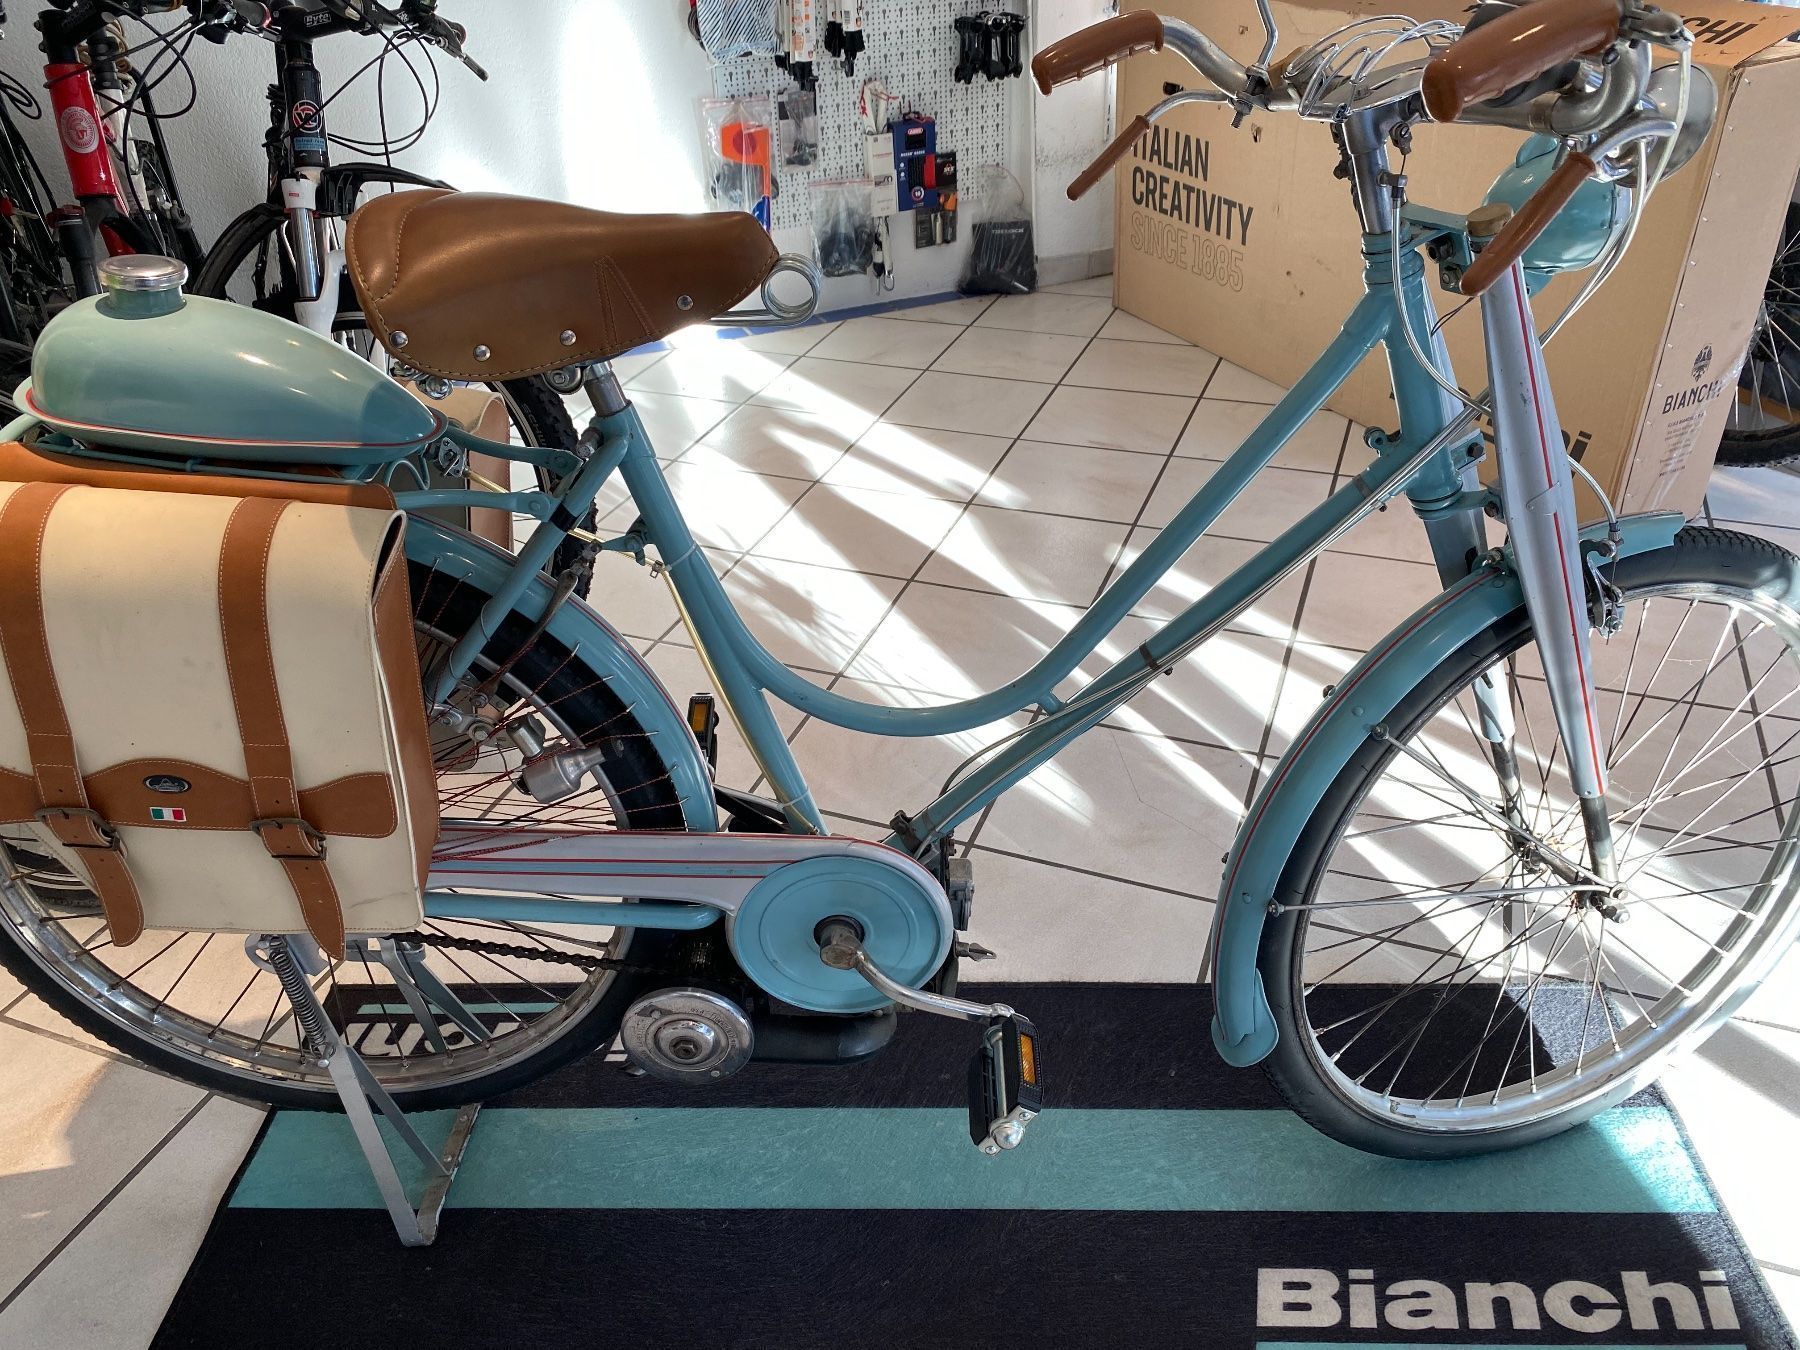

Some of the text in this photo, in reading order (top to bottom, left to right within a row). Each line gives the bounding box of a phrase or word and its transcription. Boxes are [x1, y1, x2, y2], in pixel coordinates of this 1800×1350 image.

[1132, 166, 1254, 246] CREATIVITY
[1130, 210, 1244, 292] SINCE 1885
[1256, 1267, 1741, 1333] Bianchi
